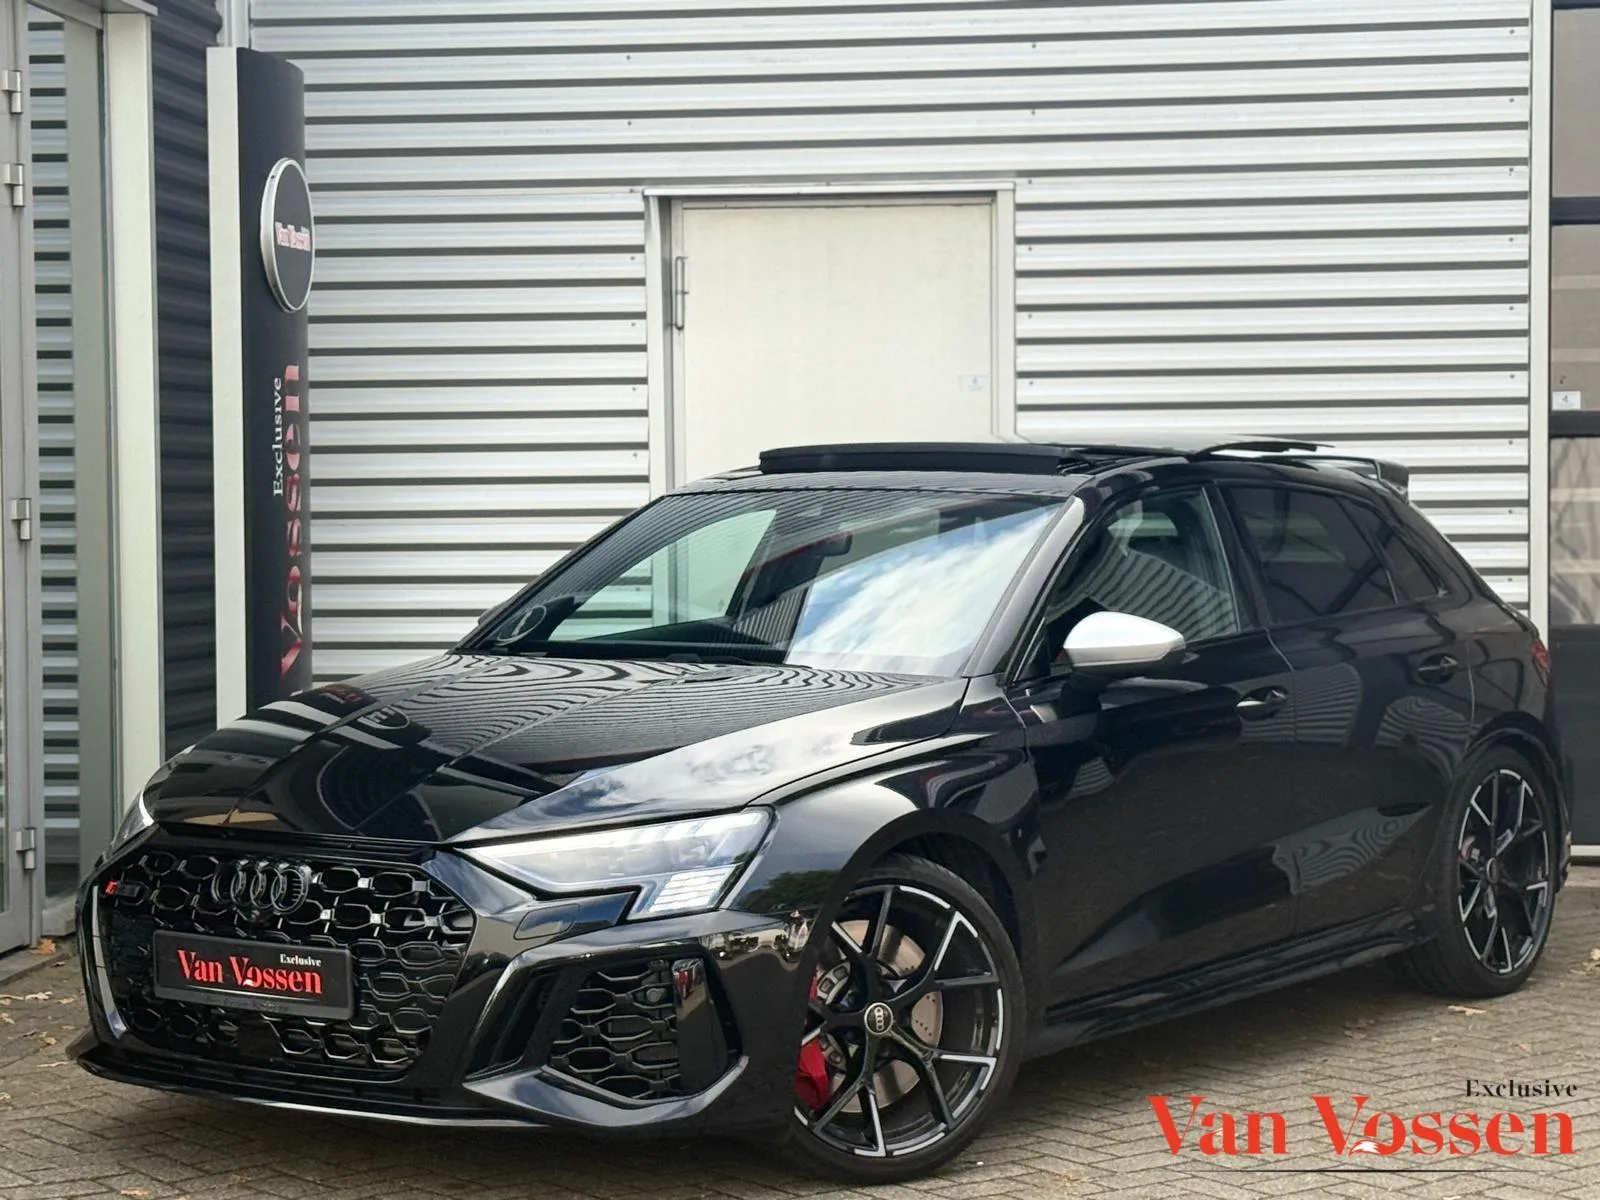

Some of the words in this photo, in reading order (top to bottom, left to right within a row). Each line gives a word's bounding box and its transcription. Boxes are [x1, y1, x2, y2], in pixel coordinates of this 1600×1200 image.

[272, 376, 284, 497] Exclusive
[280, 364, 303, 677] Vossen
[177, 948, 224, 984] Van
[228, 955, 323, 995] Vossen
[279, 953, 322, 968] Exclusive
